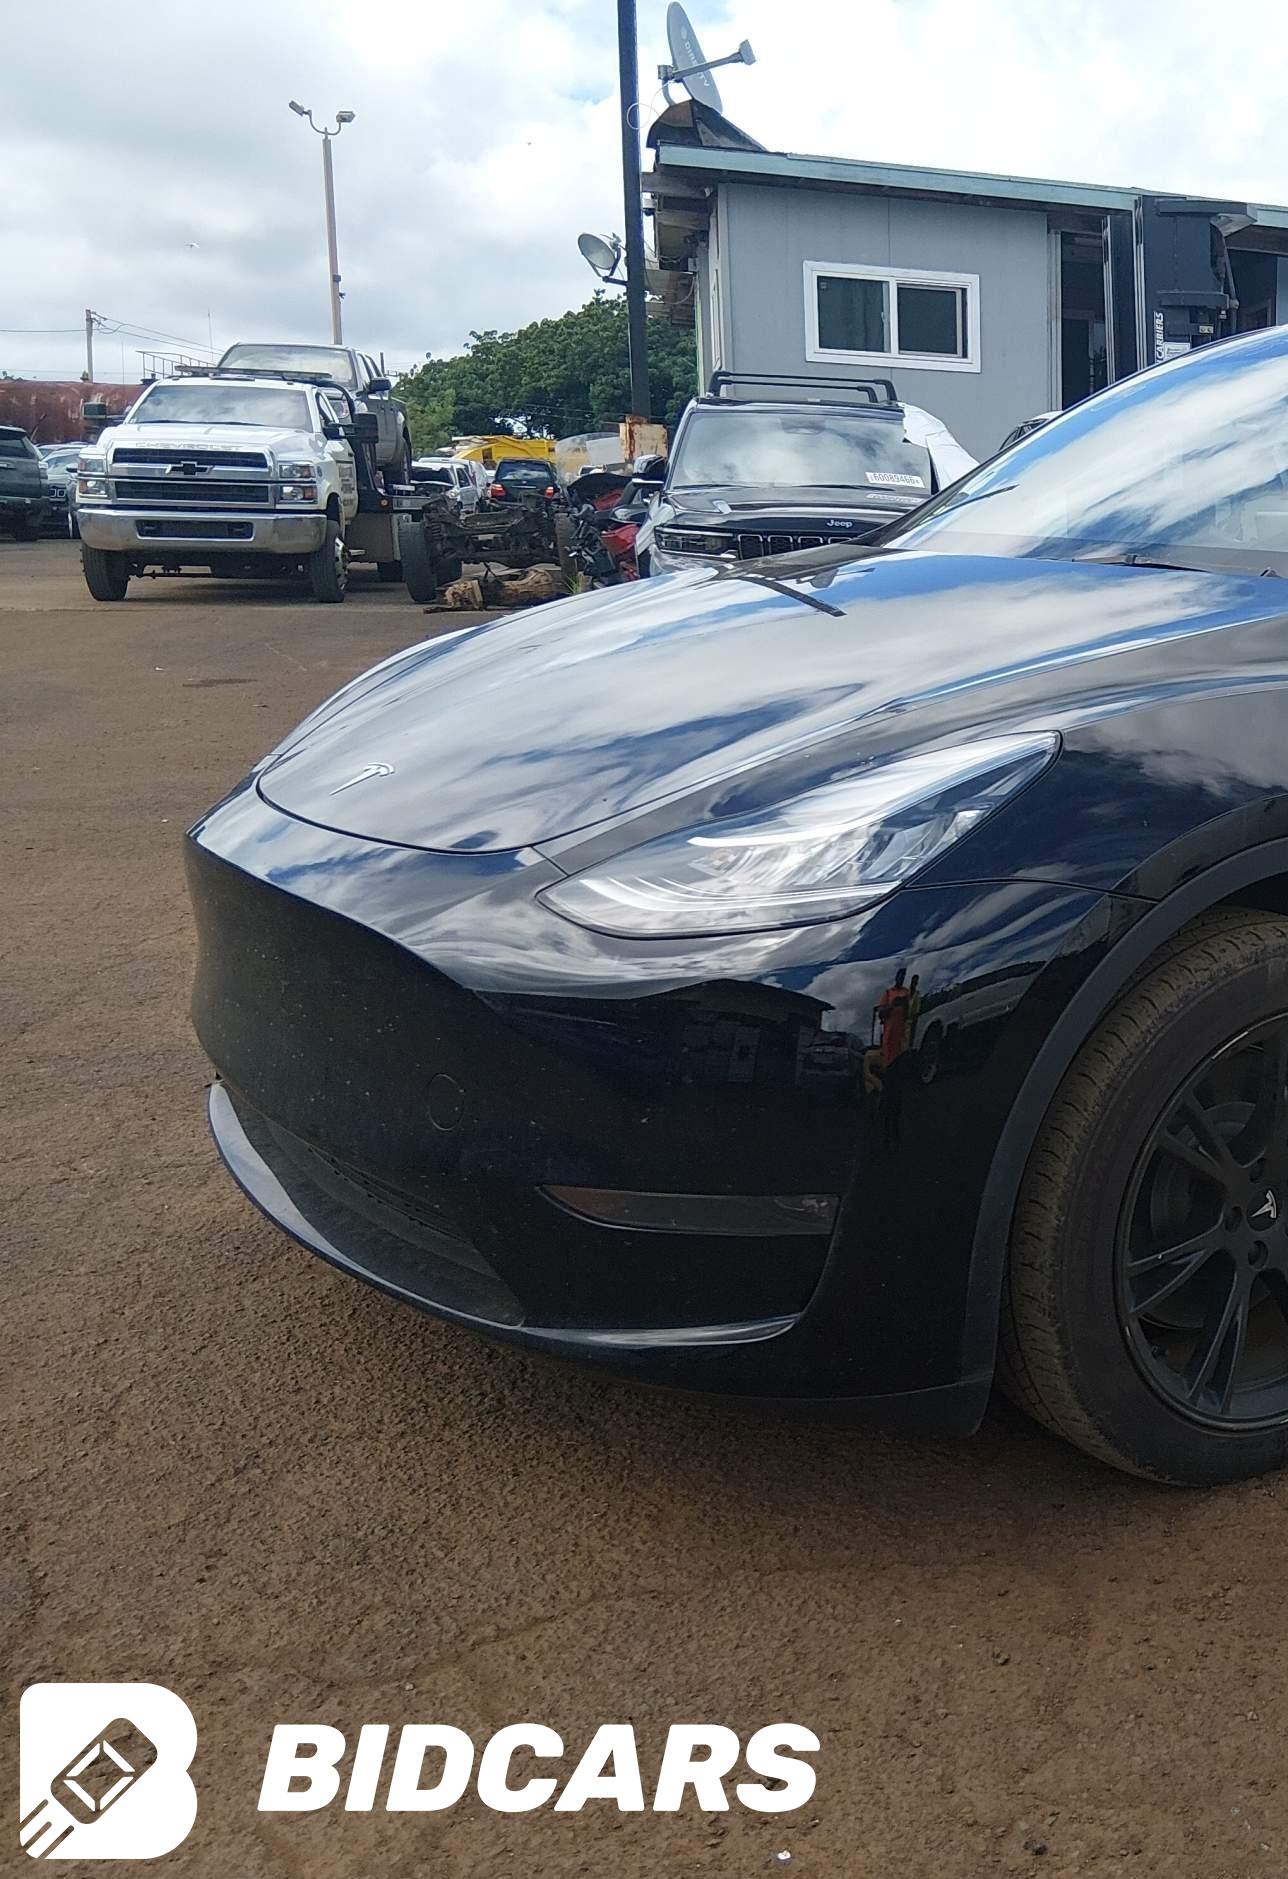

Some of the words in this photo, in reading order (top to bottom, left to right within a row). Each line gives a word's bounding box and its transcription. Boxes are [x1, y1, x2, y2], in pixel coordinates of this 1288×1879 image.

[1155, 311, 1164, 360] CARRIERS
[135, 441, 243, 451] CHEVROLET
[826, 519, 853, 529] Jeep
